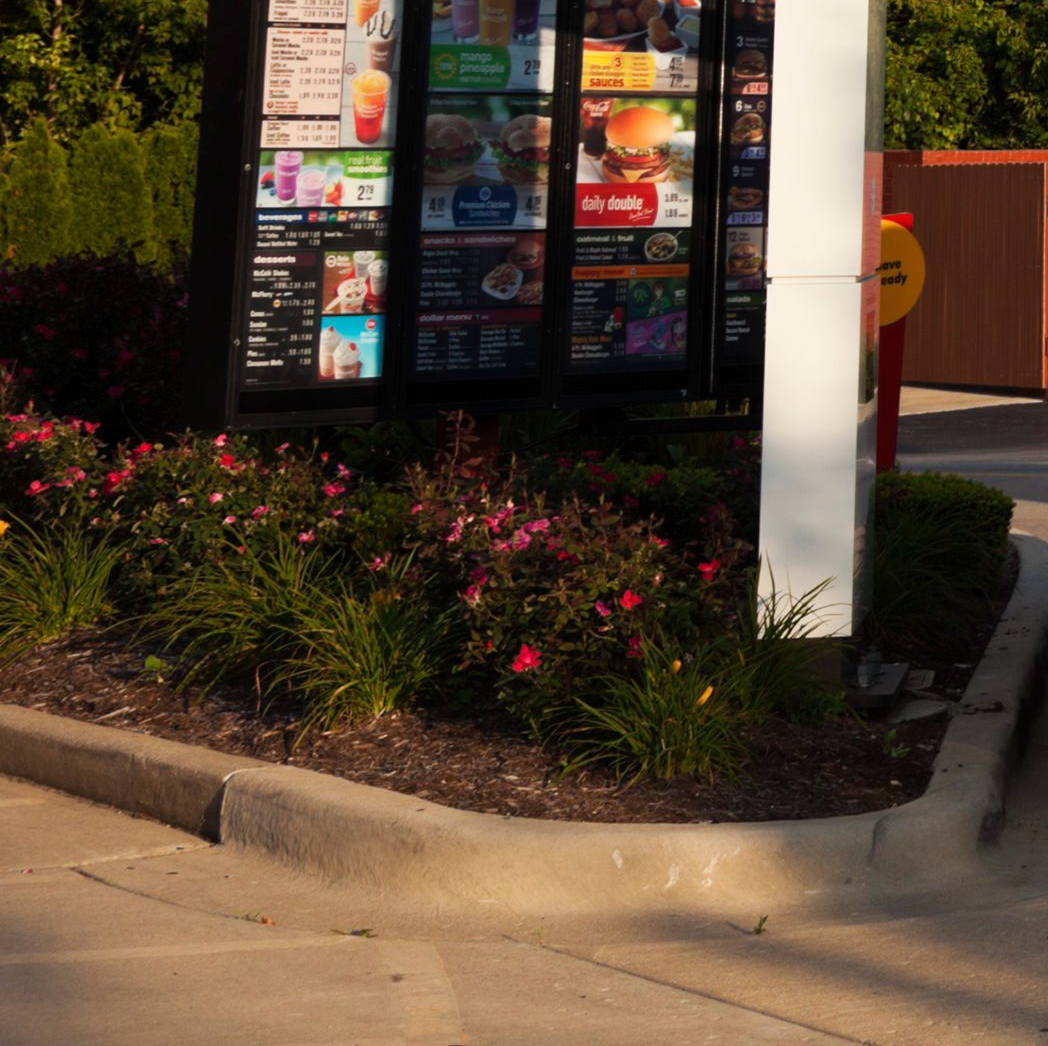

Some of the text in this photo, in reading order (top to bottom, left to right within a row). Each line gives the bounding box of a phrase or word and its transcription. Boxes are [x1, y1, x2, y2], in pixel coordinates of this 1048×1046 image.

[736, 36, 744, 47] 3
[460, 52, 492, 64] mango
[614, 57, 622, 68] 3
[460, 63, 505, 75] pineapple
[589, 77, 625, 88] sauces
[735, 100, 743, 112] 6
[349, 156, 383, 165] real fruit
[347, 165, 388, 174] smoothies
[732, 165, 740, 177] 9
[582, 194, 644, 214] daily double
[258, 213, 303, 224] beverages
[424, 236, 455, 245] snacks
[464, 234, 516, 244] sandwiches
[576, 235, 610, 243] oatmeal
[617, 234, 634, 242] fruit
[253, 255, 297, 265] desserts
[880, 259, 902, 271] ave
[880, 271, 908, 286] eady
[726, 295, 751, 304] salads
[419, 313, 473, 322] dollar menu
